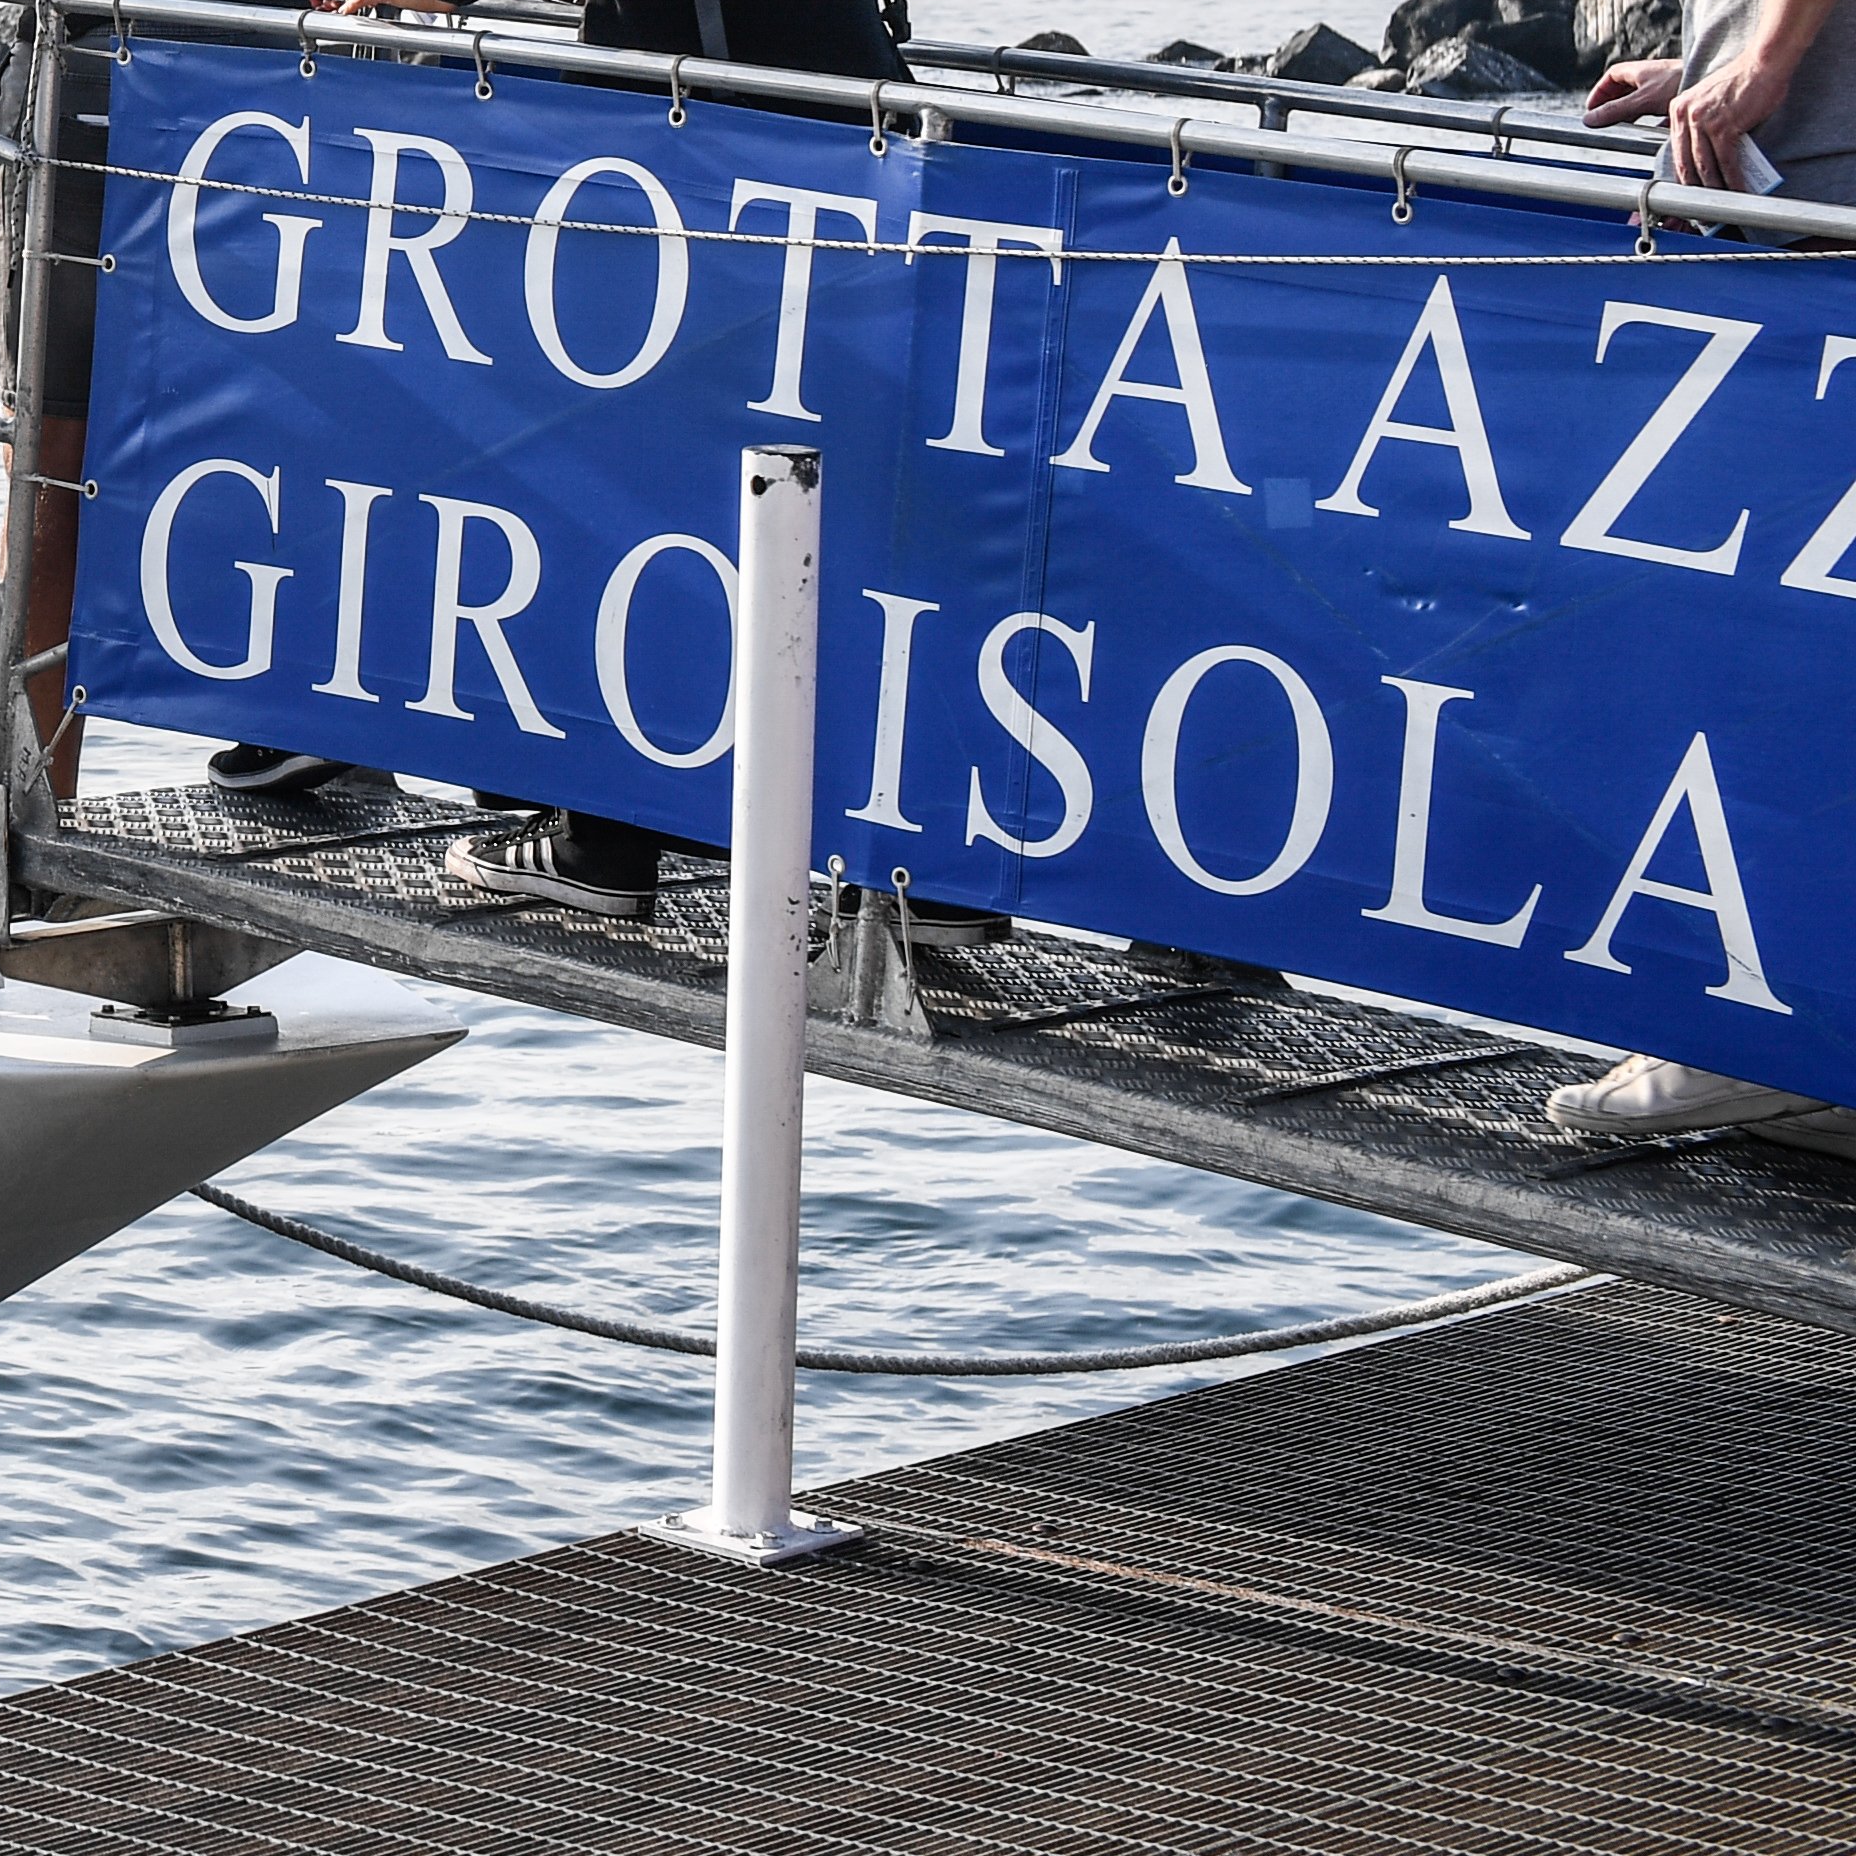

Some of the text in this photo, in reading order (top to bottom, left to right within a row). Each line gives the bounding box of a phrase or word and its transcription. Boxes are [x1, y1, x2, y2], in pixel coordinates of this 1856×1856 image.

[166, 108, 1254, 497] GROTTA
[139, 457, 1794, 1016] GIRO ISOLA
